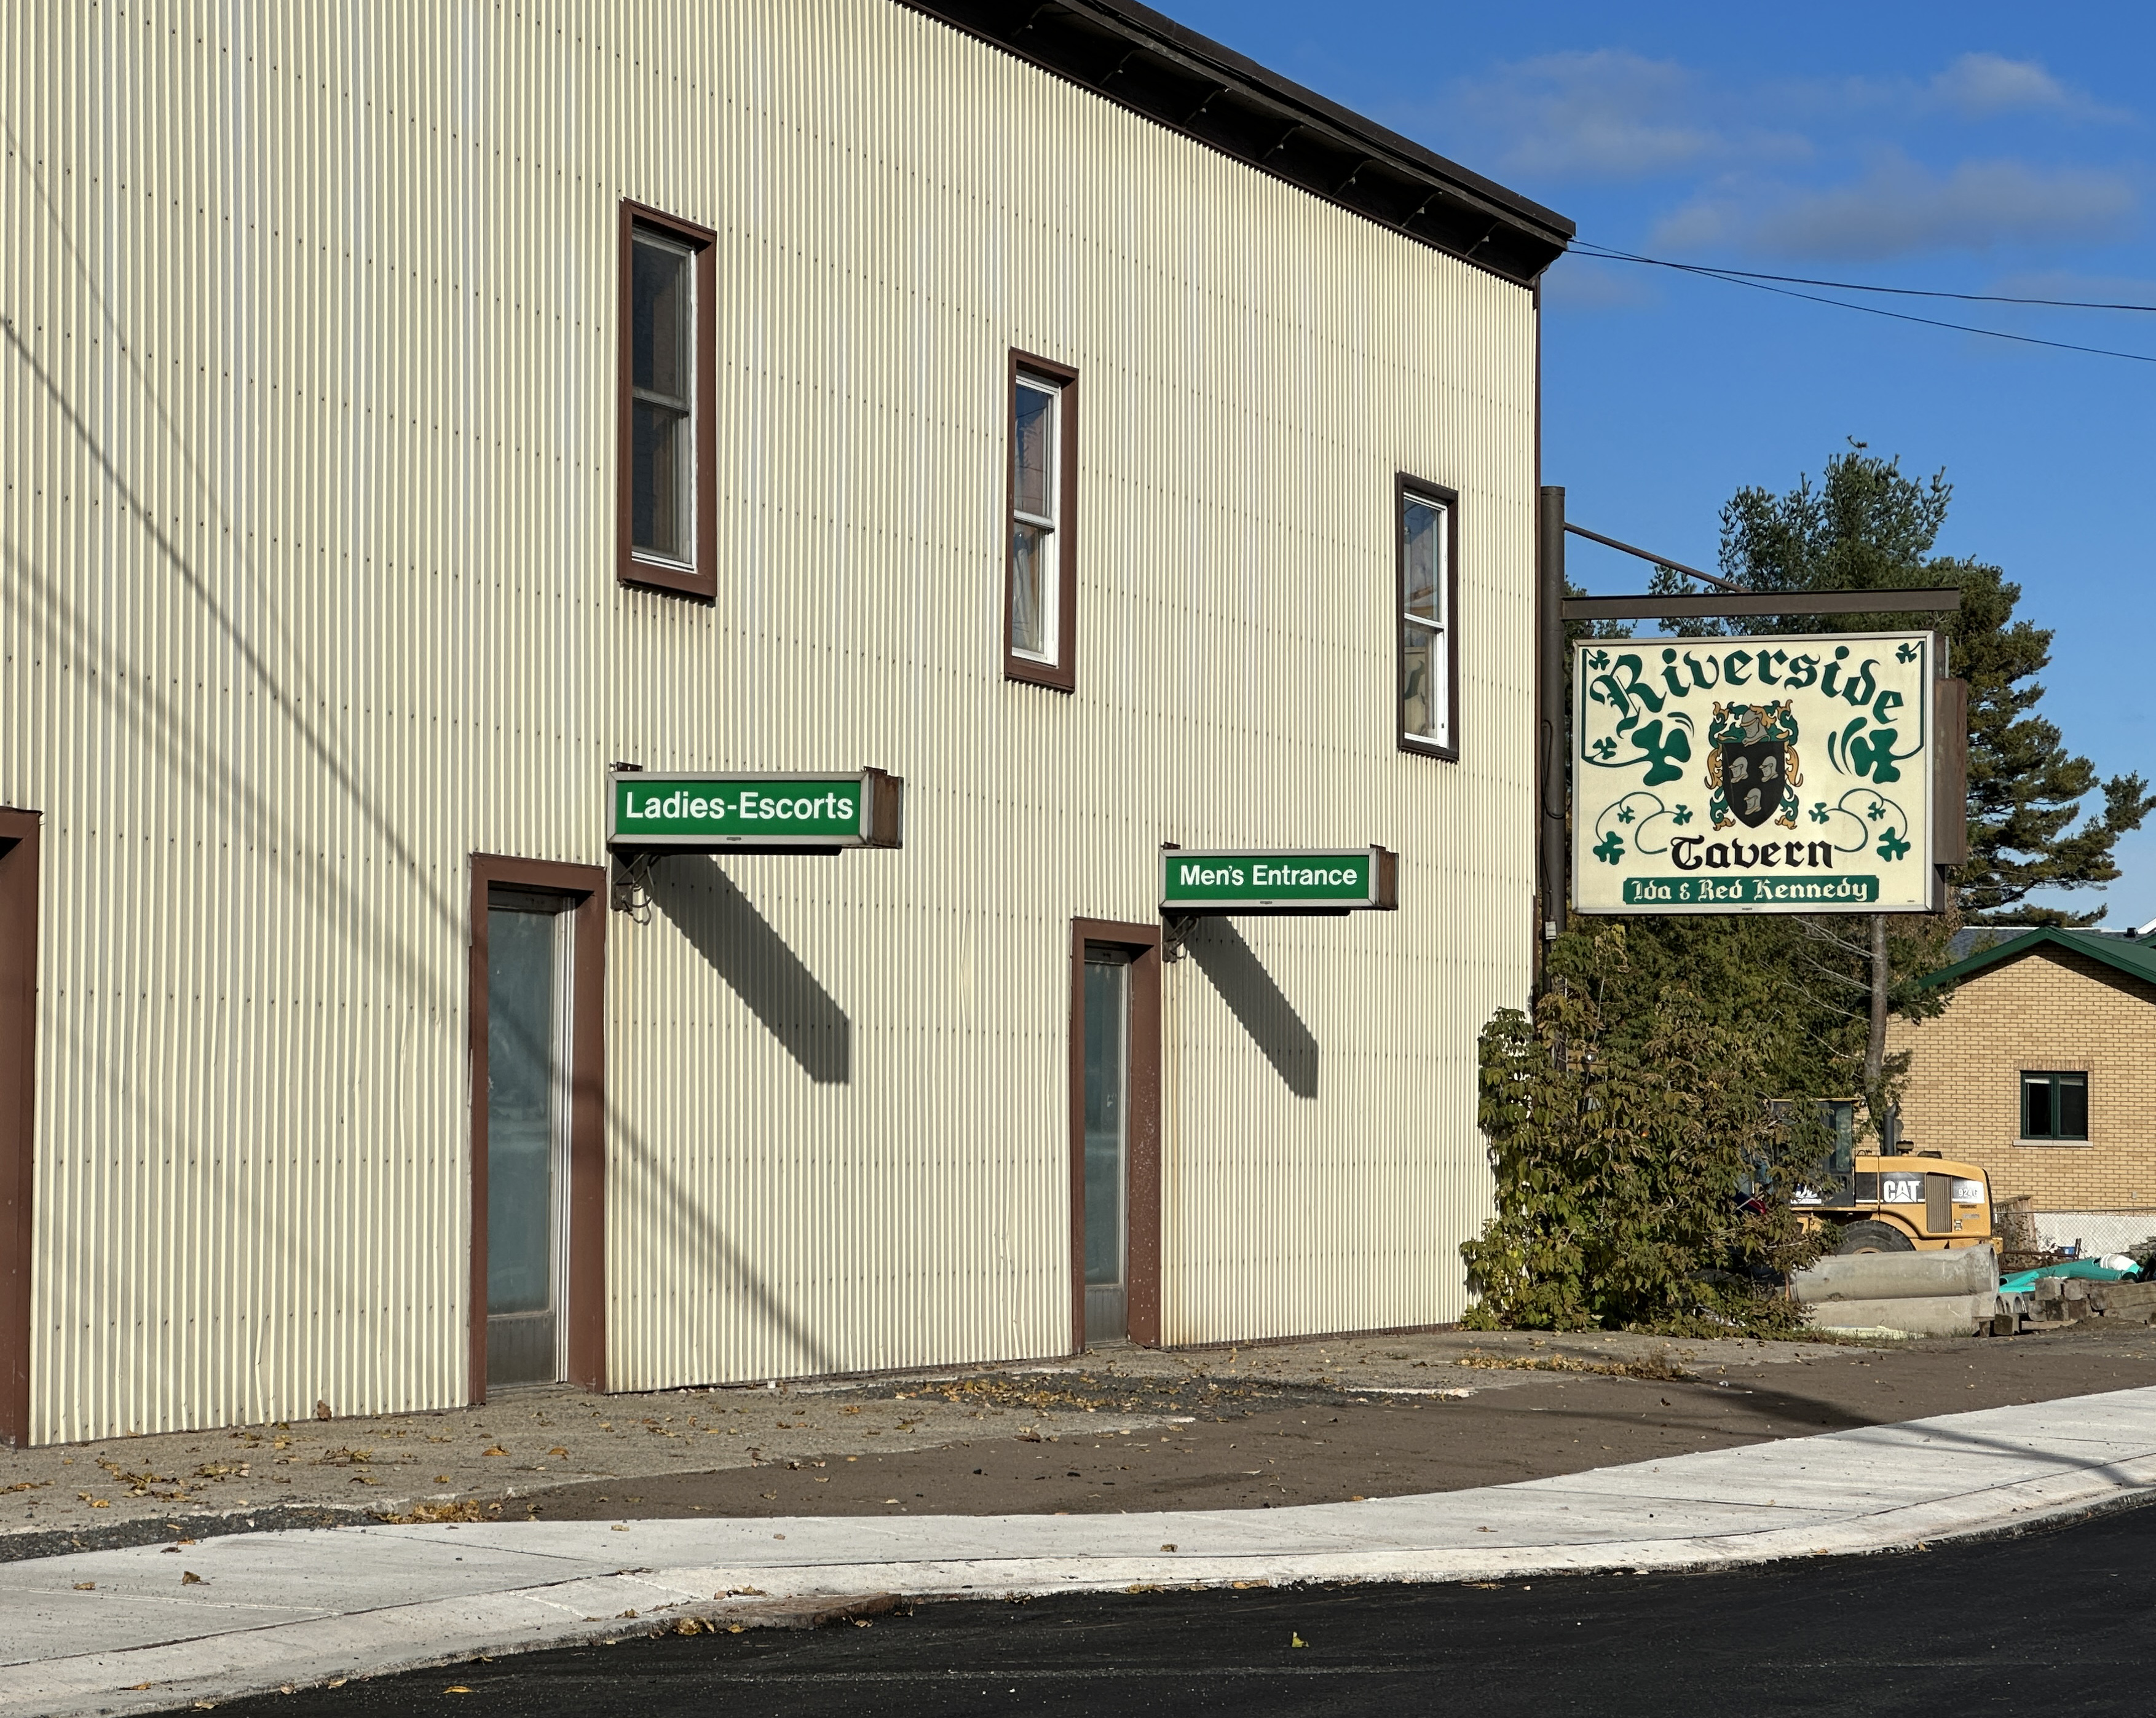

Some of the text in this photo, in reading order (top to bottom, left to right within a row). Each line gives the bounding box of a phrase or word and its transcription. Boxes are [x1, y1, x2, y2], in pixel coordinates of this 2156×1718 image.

[1590, 645, 1903, 738] Riverside
[626, 790, 853, 819] Ladies-Escorts
[1670, 835, 1833, 870] Tavern
[1180, 864, 1357, 886] Men's Entrance
[1631, 877, 1868, 902] Ida & Red Kennedy
[1884, 1181, 1921, 1202] CAT
